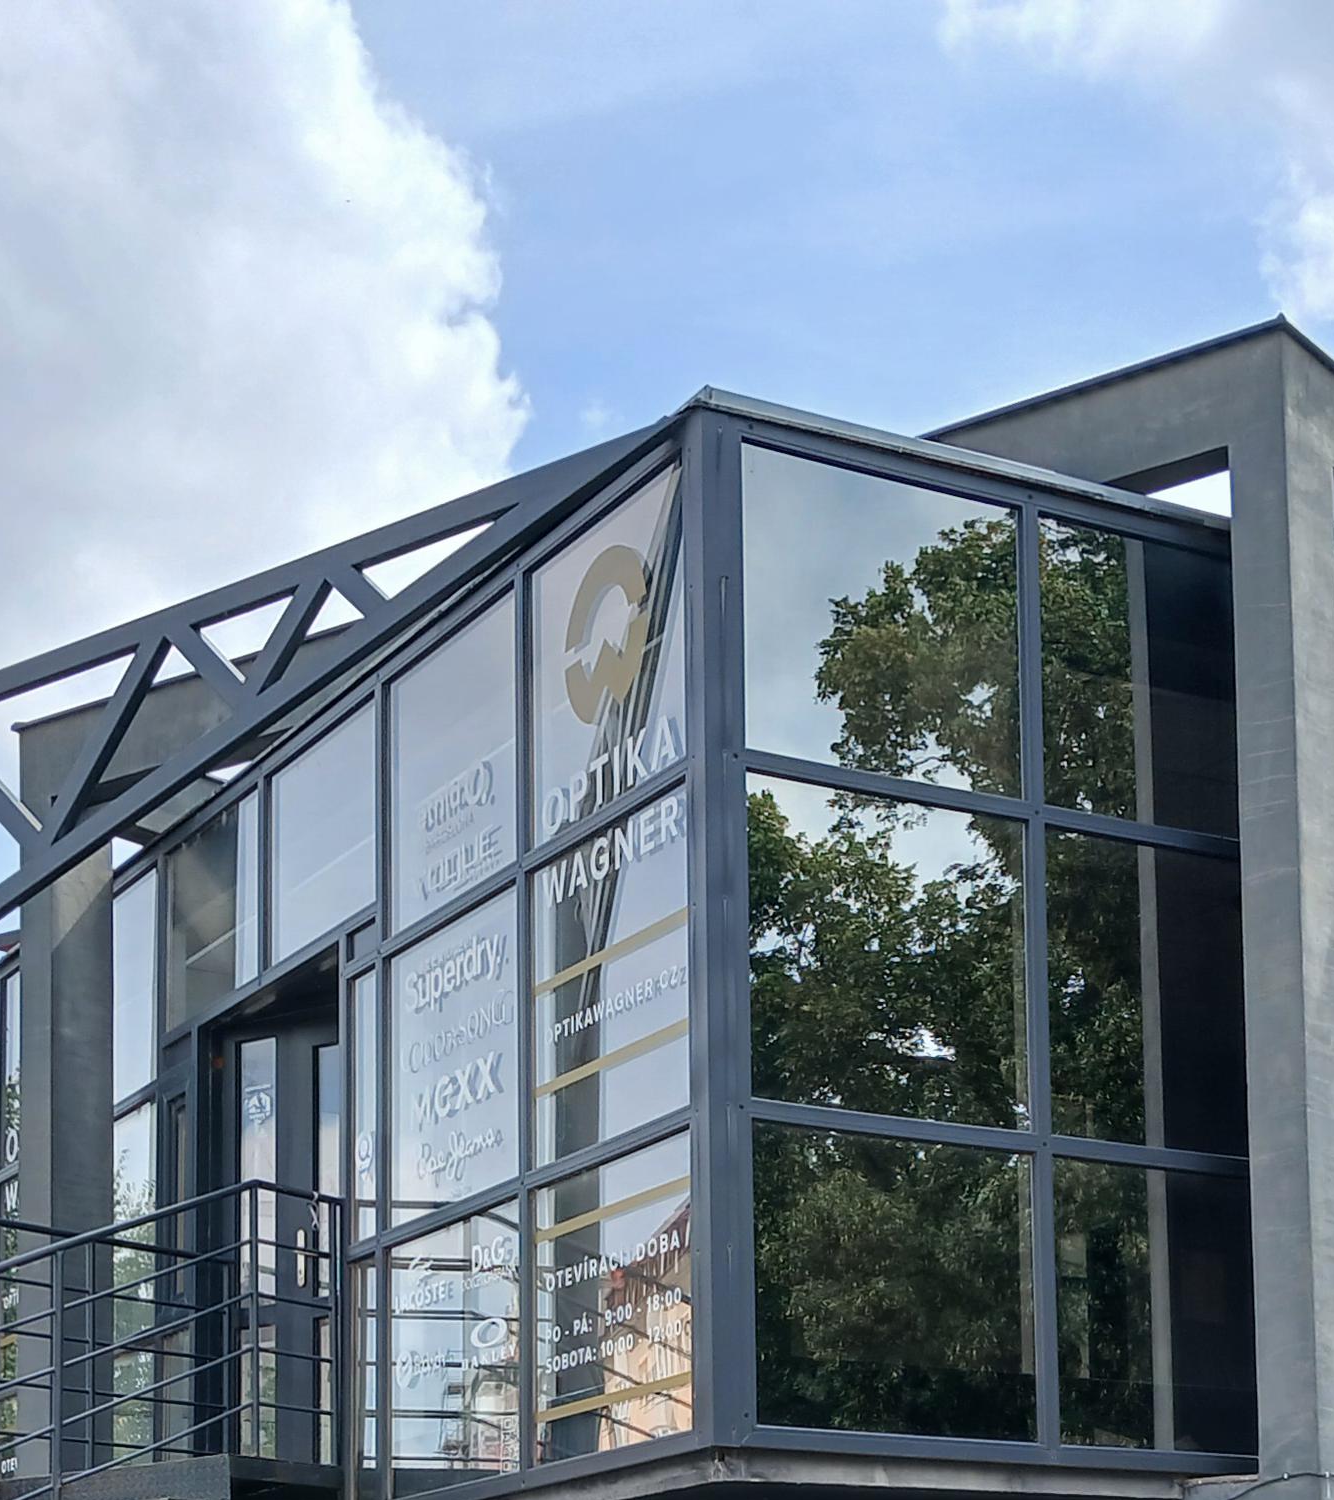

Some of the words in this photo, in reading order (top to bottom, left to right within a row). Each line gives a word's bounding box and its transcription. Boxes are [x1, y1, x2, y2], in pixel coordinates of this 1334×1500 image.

[542, 714, 679, 836] OPTIKA
[542, 796, 679, 908] WAGNER
[471, 1235, 505, 1275] D&G
[635, 1229, 681, 1262] DOBA
[573, 1312, 593, 1336] PÁ:
[605, 1303, 633, 1326] 9:00
[647, 1287, 682, 1311] 18:00
[545, 1346, 597, 1374] SOBOTA:
[601, 1334, 634, 1358] 10:00
[648, 1319, 682, 1343] 12:00
